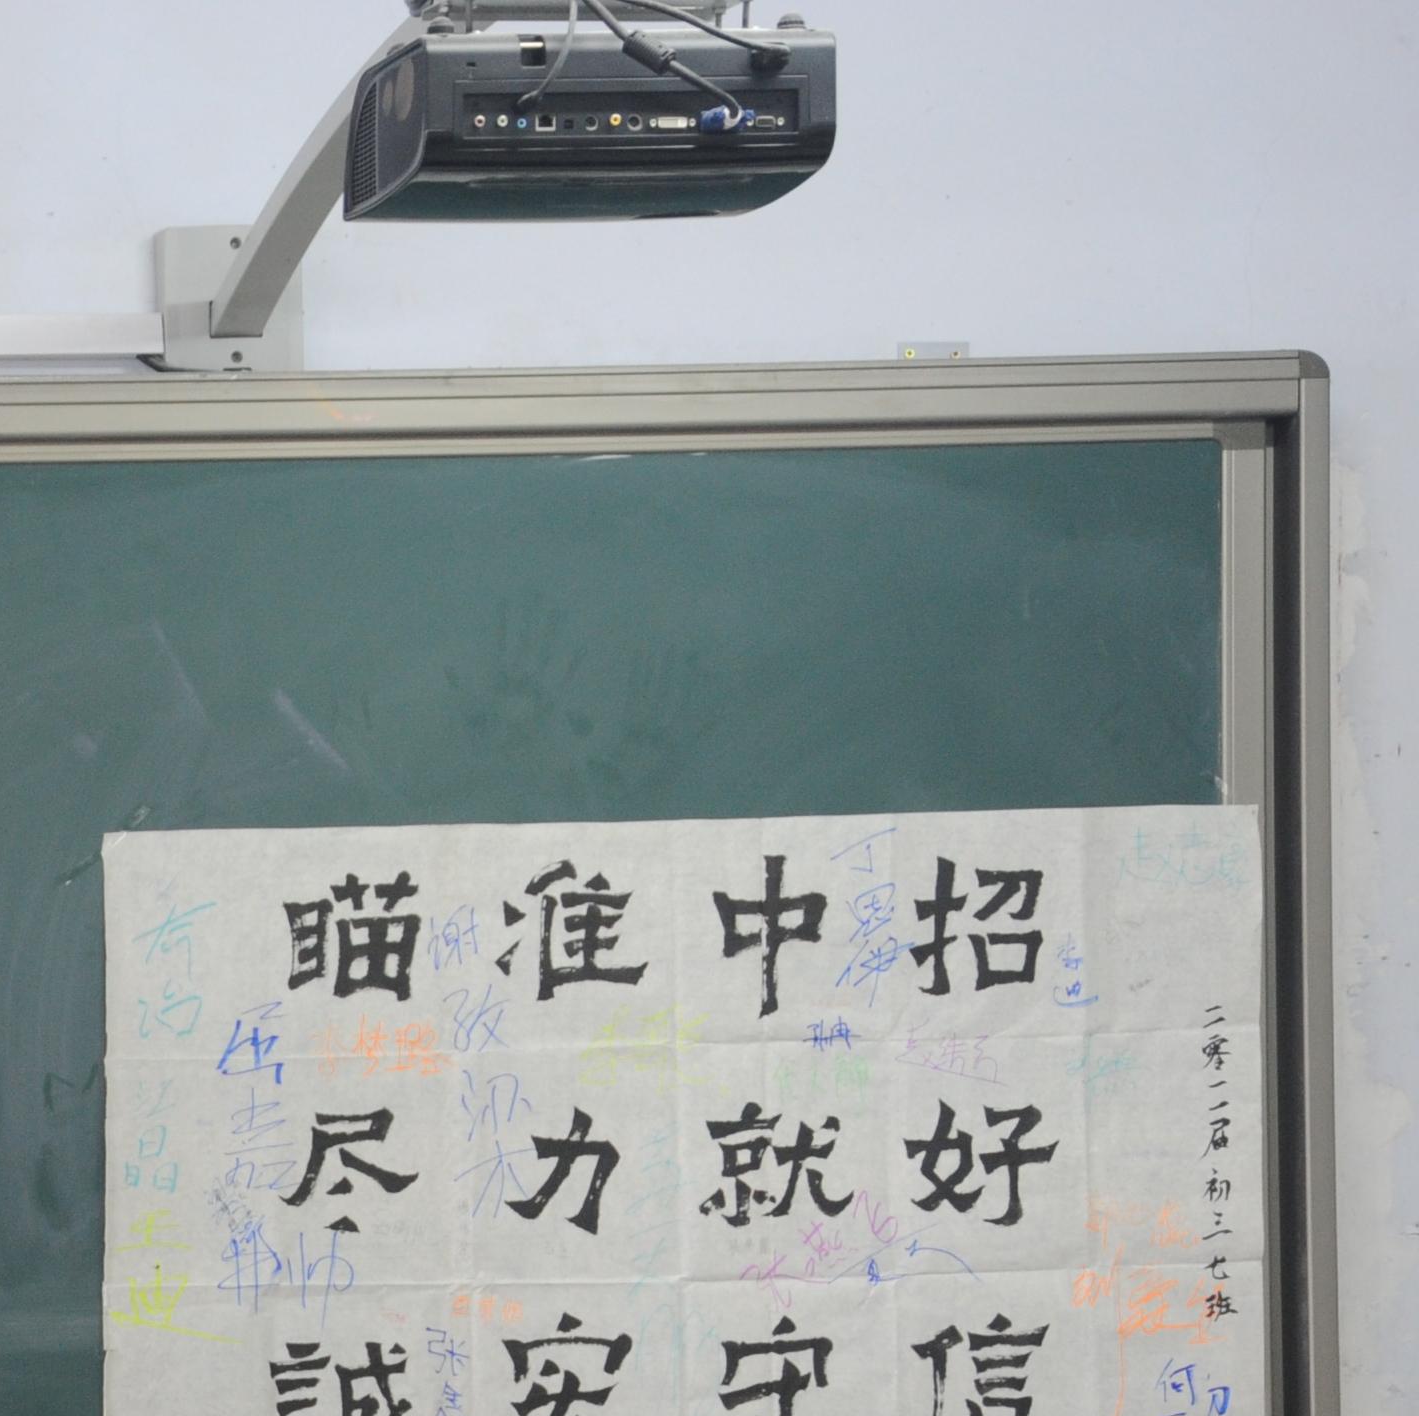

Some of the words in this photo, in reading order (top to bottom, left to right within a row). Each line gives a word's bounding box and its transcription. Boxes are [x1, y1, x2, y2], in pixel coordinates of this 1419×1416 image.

[284, 856, 1043, 1017] 瞄准中招
[284, 1102, 1058, 1234] 尽力就好
